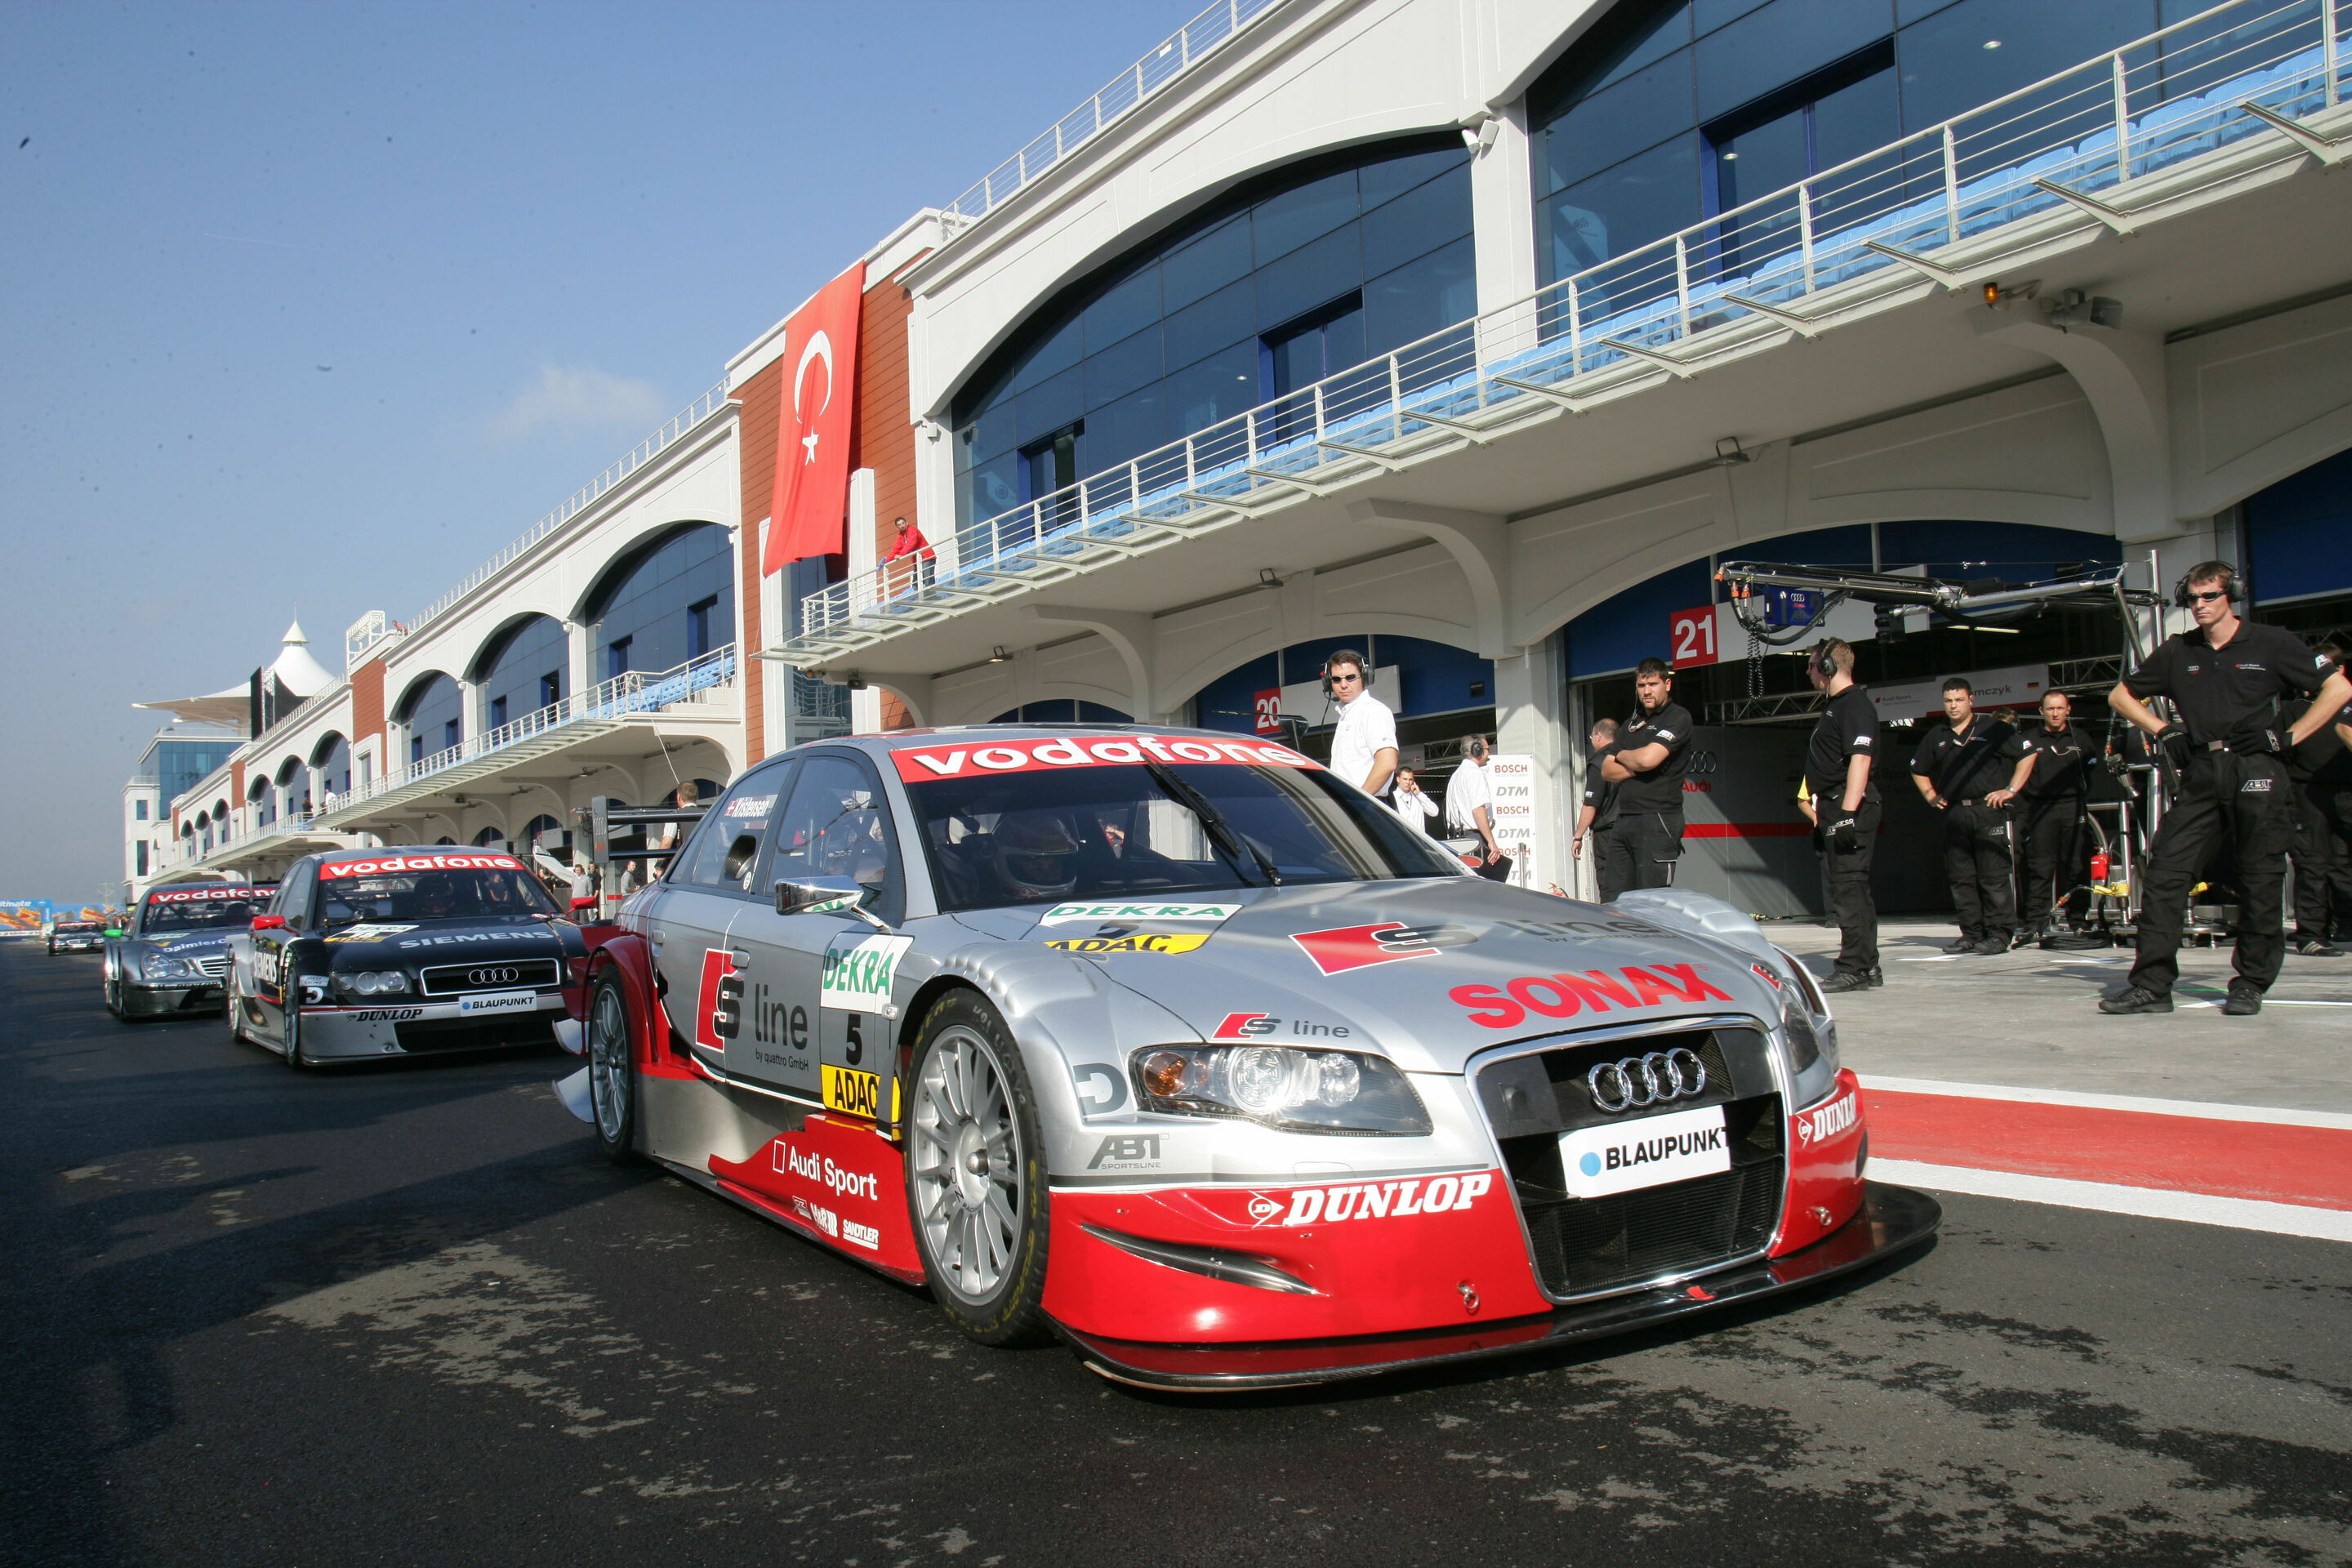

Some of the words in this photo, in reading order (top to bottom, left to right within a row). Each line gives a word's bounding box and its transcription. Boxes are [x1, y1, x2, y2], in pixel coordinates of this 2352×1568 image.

[1675, 614, 1713, 660] 21
[1257, 697, 1281, 728] 20
[913, 737, 1307, 774] vodafone
[1494, 764, 1528, 773] BOSCH
[1496, 786, 1529, 796] DTM
[1682, 779, 1713, 792] Audi
[1496, 806, 1530, 815] BOSCH
[1498, 828, 1530, 839] DTM
[1499, 848, 1531, 857] BOSH
[329, 856, 516, 876] vodafone
[1047, 906, 1226, 916] DEKRA
[1494, 919, 1662, 936] line
[399, 931, 555, 948] SIEMENS
[1049, 935, 1172, 951] ADAC
[823, 948, 895, 996] DEKRA
[472, 996, 535, 1009] BLAUPUNKT
[1448, 963, 1735, 1029] SONAX
[357, 1009, 423, 1021] DUNLOP
[755, 983, 808, 1050] line
[1293, 1020, 1350, 1038] line
[846, 1013, 862, 1066] 5
[756, 1048, 764, 1061] by
[764, 1050, 787, 1067] quattro
[788, 1056, 809, 1071] GmbH
[834, 1069, 878, 1117] ADAC
[1087, 1134, 1160, 1169] ABT
[789, 1146, 821, 1182] Audi
[824, 1157, 878, 1200] Sport
[1101, 1161, 1162, 1169] SPORTSLINE
[1282, 1174, 1492, 1227] DUNLOP
[843, 1219, 879, 1244] SANDTLER
